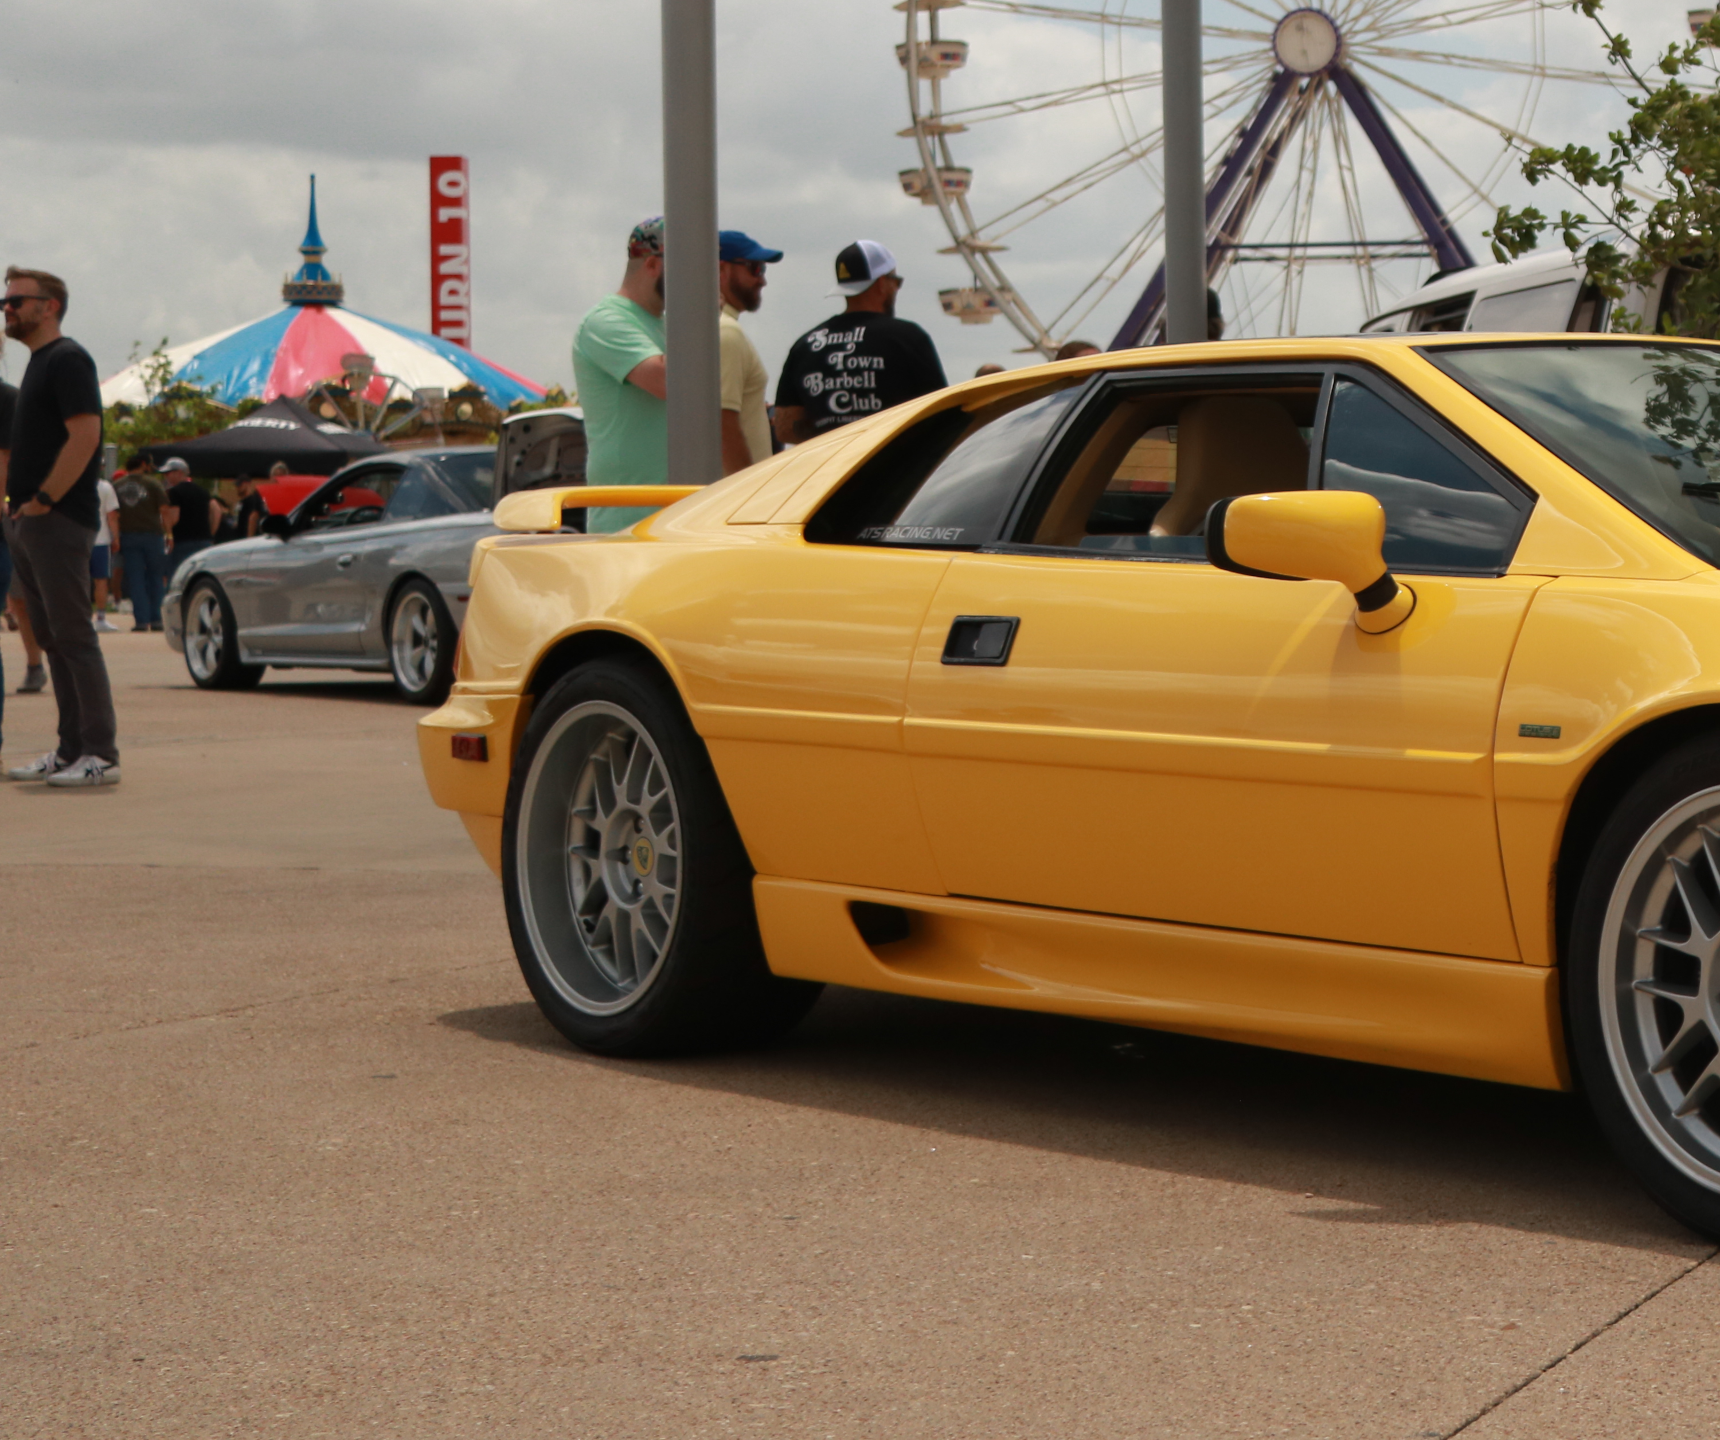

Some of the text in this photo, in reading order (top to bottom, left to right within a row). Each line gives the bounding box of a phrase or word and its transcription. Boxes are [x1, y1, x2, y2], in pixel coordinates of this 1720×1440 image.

[437, 170, 470, 340] URN 10
[807, 326, 866, 352] Small
[828, 342, 885, 370] Town
[803, 371, 876, 397] Barbell
[828, 390, 883, 414] Club
